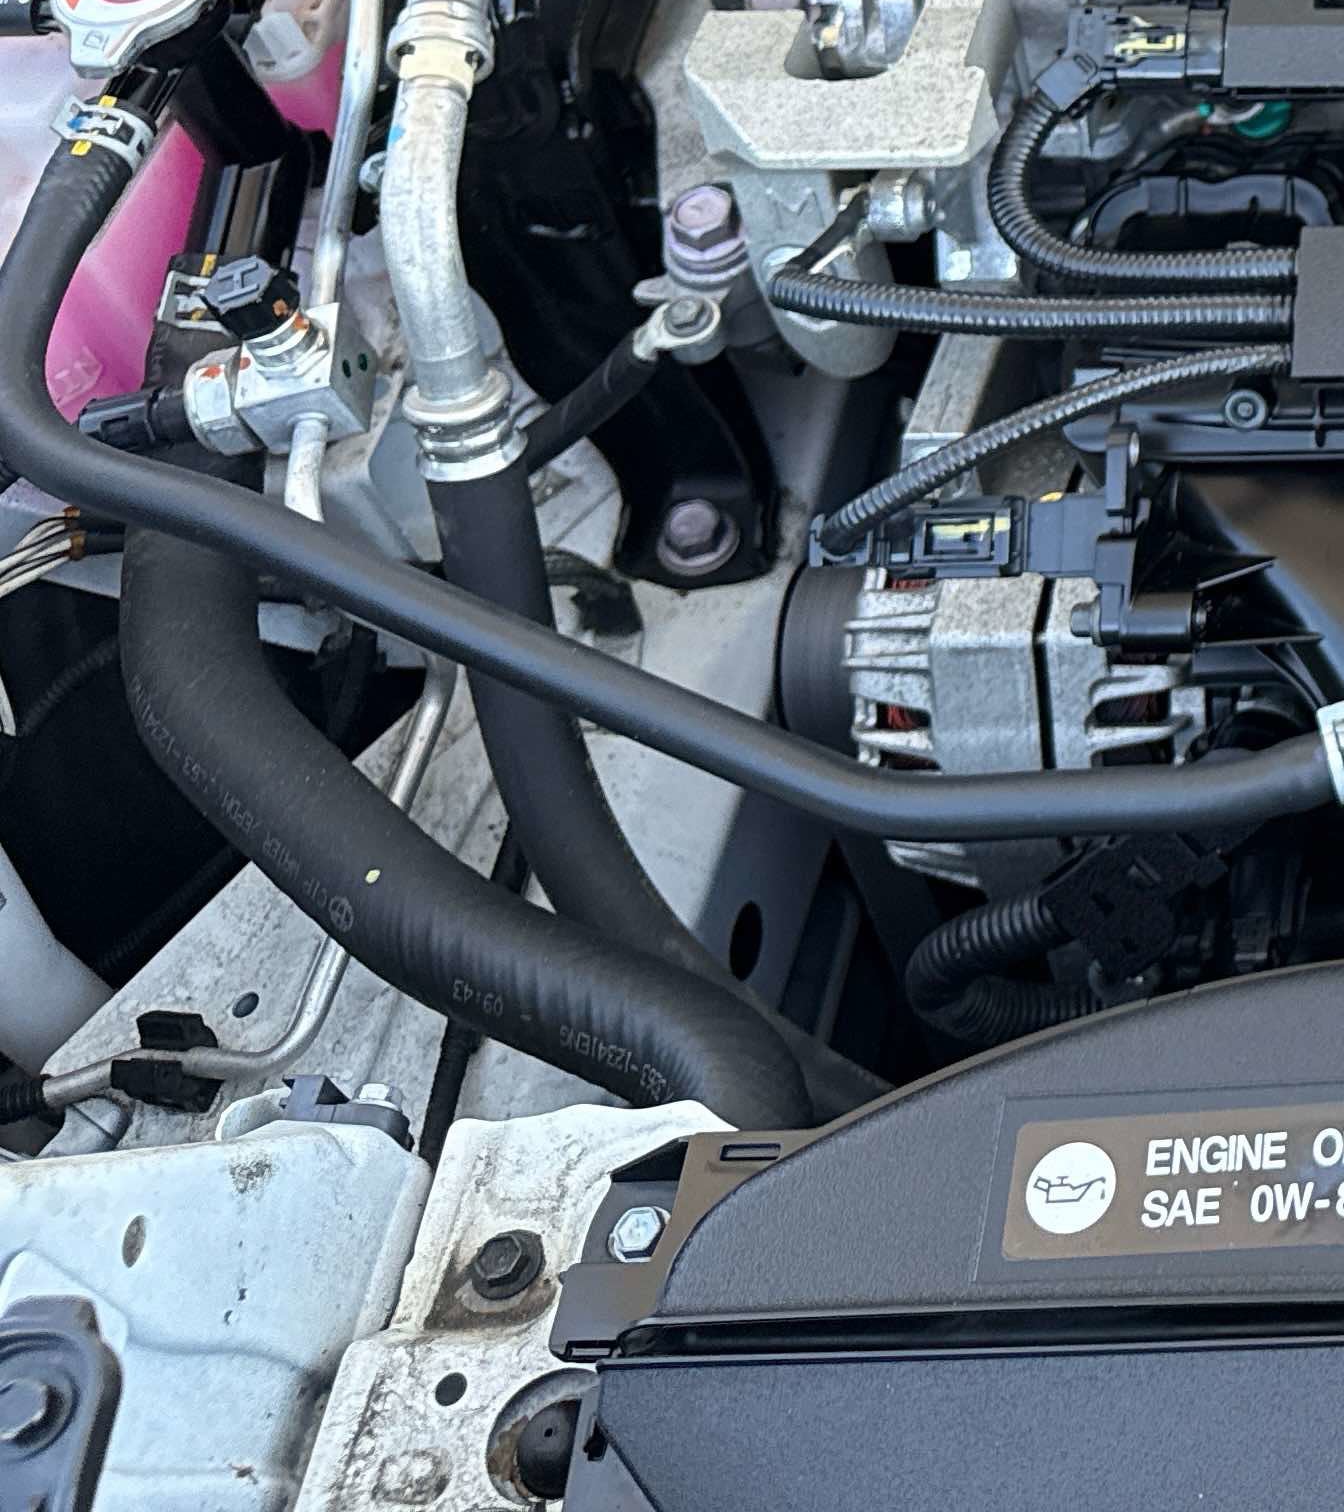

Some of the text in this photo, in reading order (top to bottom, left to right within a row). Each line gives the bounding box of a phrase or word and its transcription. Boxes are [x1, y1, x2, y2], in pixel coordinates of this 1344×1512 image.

[449, 978, 507, 1017] 09:43
[1146, 1131, 1287, 1176] ENGINE
[1141, 1187, 1222, 1228] SAE
